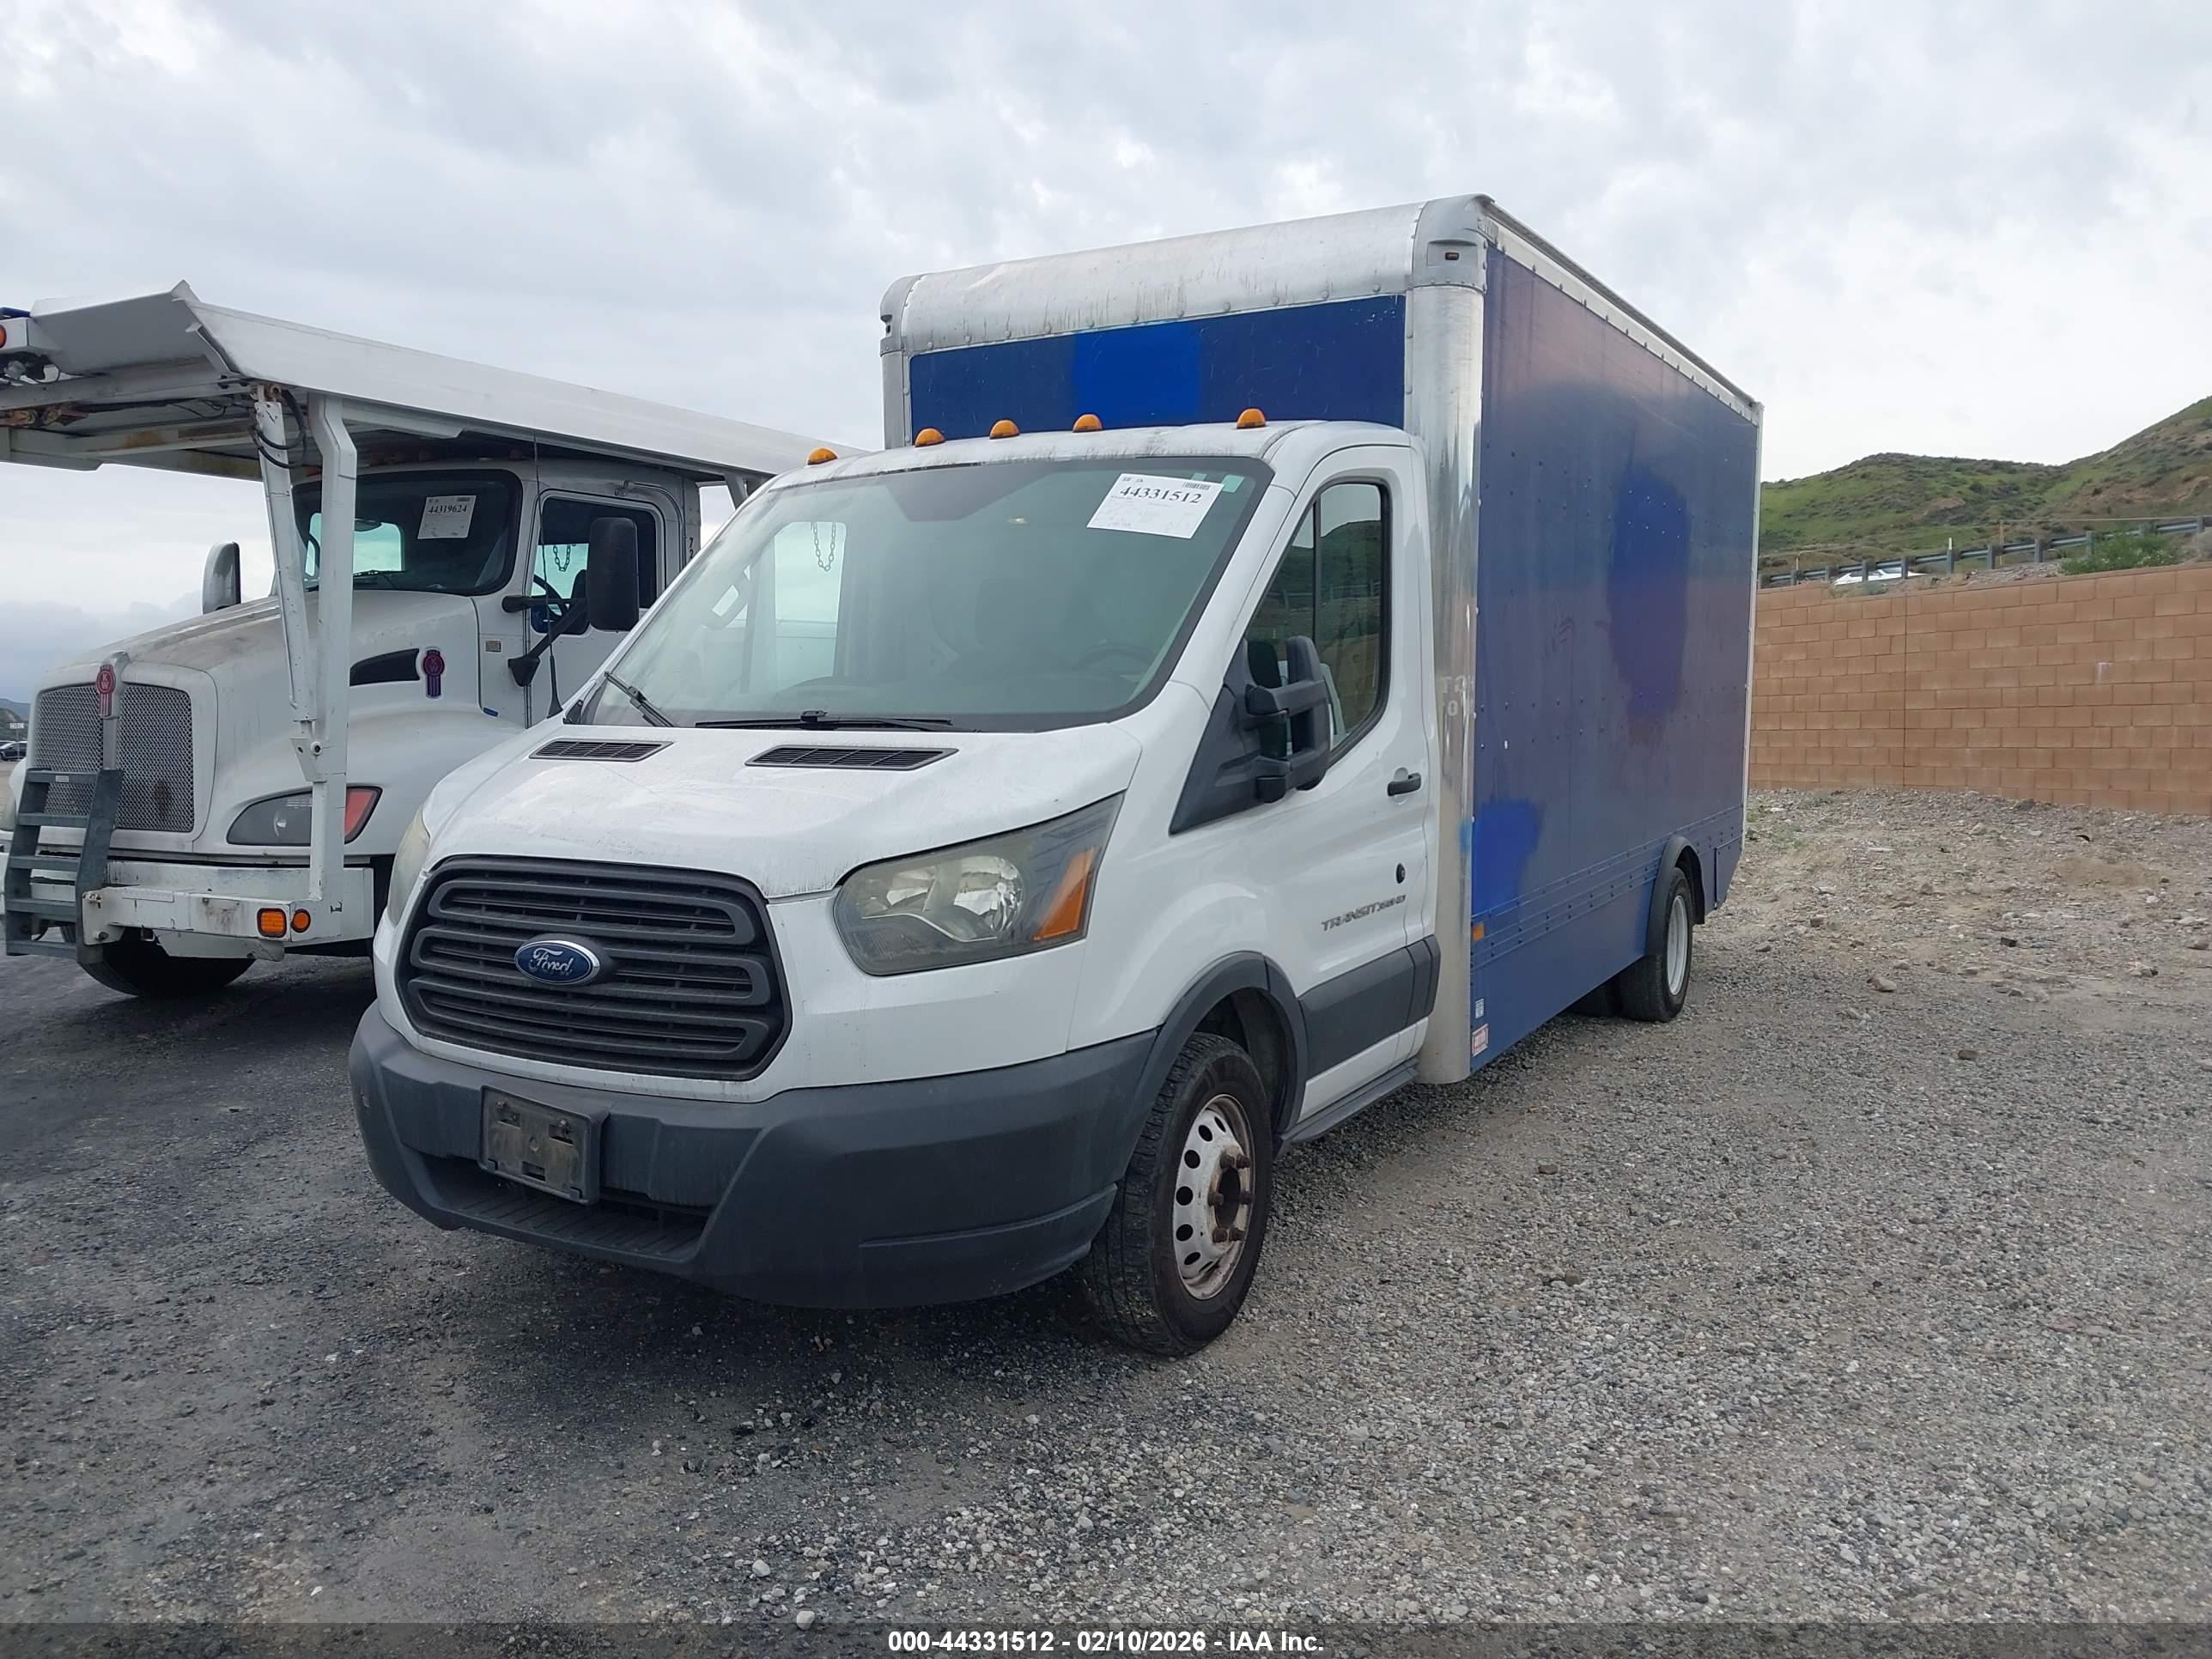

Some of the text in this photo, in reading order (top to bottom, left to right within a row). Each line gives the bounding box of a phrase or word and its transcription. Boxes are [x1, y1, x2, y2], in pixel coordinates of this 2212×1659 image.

[1120, 486, 1201, 504] 44331512
[428, 504, 467, 514] 44319624
[529, 947, 574, 975] Ford
